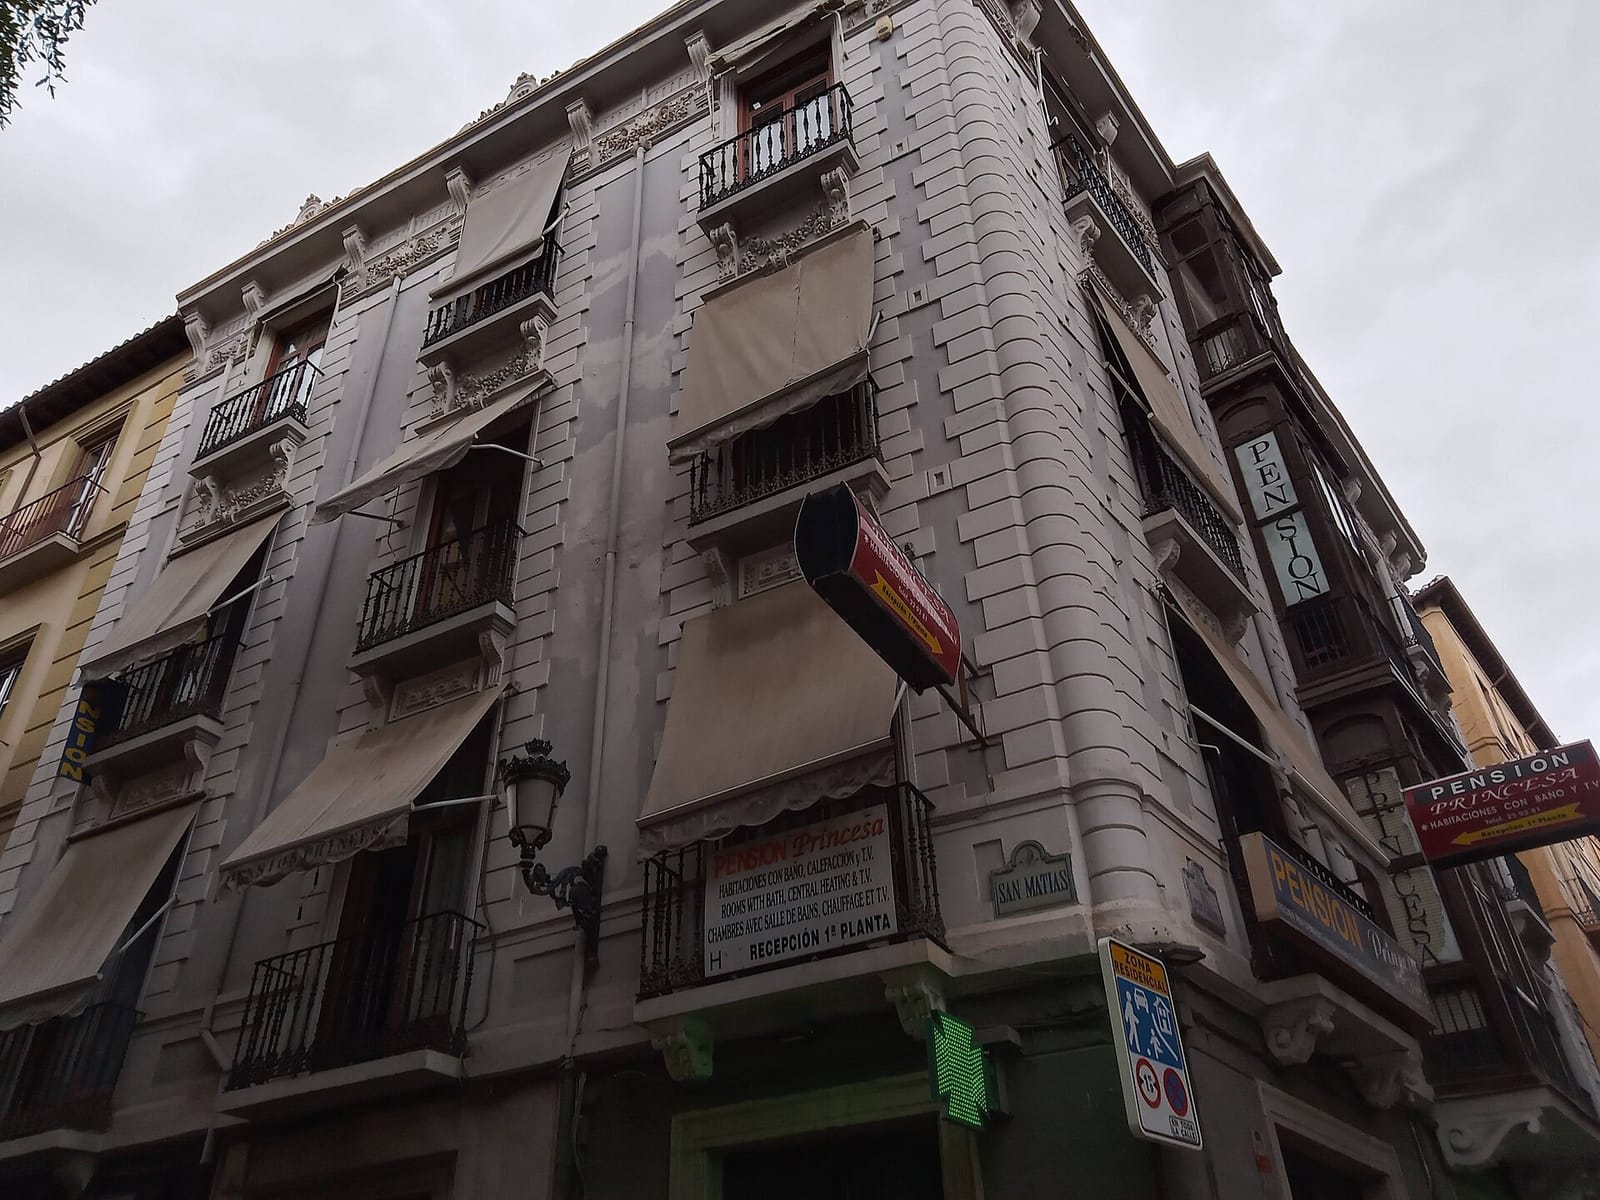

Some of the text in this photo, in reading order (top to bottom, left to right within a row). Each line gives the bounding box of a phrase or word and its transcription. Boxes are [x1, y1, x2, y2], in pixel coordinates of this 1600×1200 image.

[1248, 440, 1322, 601] PENSION
[1430, 767, 1580, 816] PRINCESA
[1431, 752, 1570, 800] PENSION
[1430, 806, 1498, 830] HABITACIONES
[1503, 798, 1528, 811] CON
[1570, 784, 1578, 794] Y
[714, 818, 884, 878] PENSION Princesa
[719, 873, 767, 899] HABITACIONES
[768, 867, 783, 886] CON
[861, 846, 874, 861] T.V.
[721, 868, 873, 919] ROOMS WITH BATH, CENTRAL HEATING & T.V.
[998, 869, 1069, 904] SAN MATIAS
[707, 886, 890, 944] CHAMBRES AVEC SALLE DE BAINS, CHAUFFAGE ET T.V.
[1271, 849, 1364, 952] PENSION
[710, 951, 722, 971] H
[750, 913, 891, 961] RECEPCIÓN 1ª PLANTA
[1113, 959, 1168, 994] RESIDENCIAL
[1124, 951, 1153, 976] ZONA
